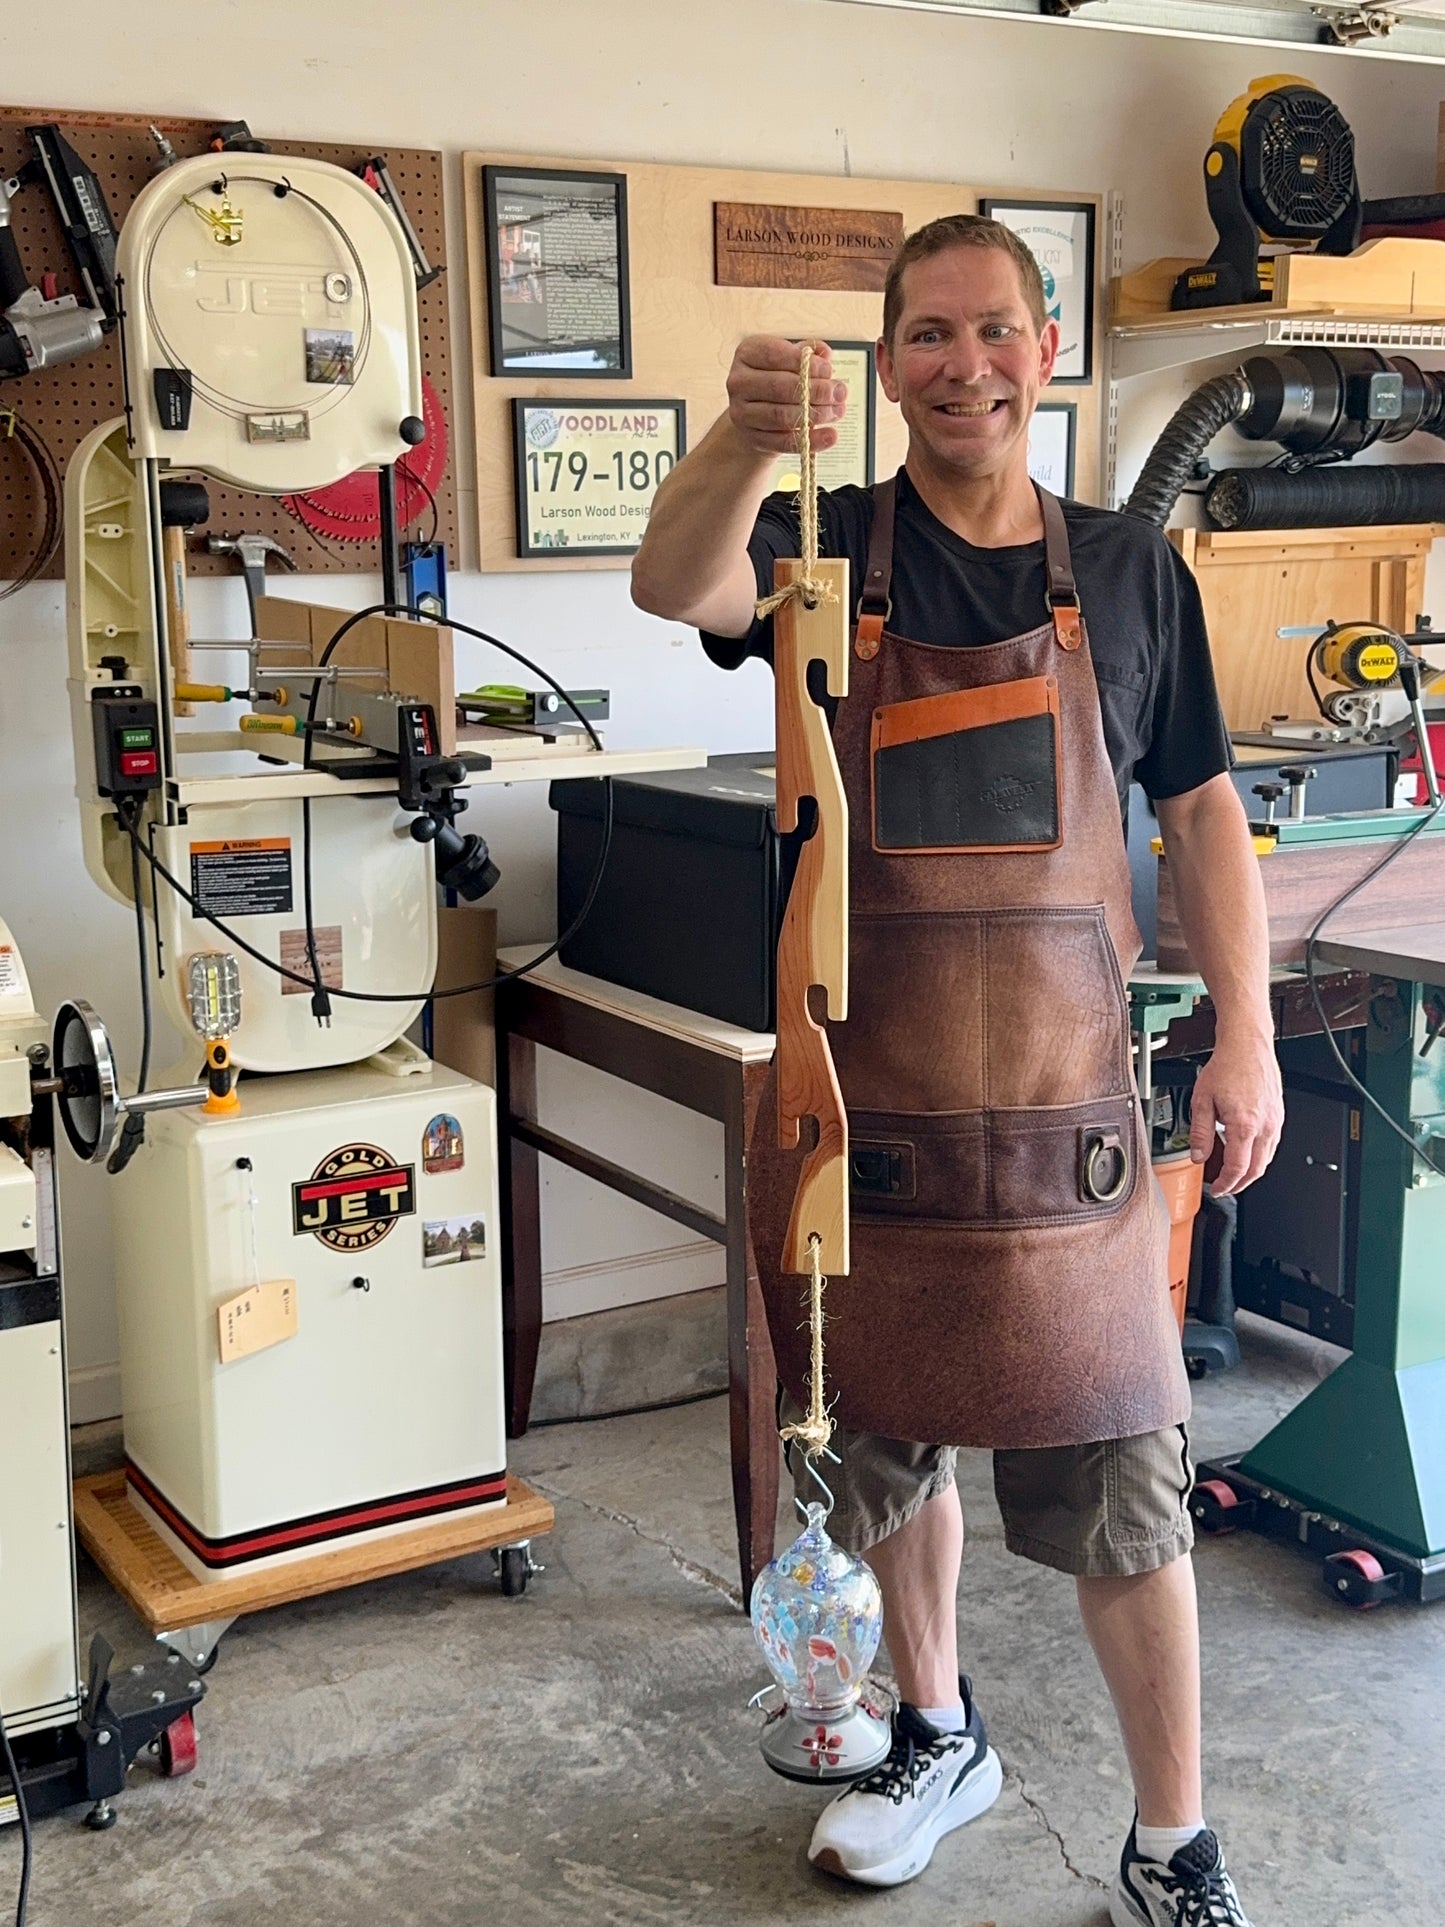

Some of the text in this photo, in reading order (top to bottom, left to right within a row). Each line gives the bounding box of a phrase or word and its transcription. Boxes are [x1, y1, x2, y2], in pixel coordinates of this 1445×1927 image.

[499, 213, 531, 221] STATEMENT
[727, 228, 894, 250] LARSON WOOD DESIGNS
[528, 450, 674, 492] 179-180
[541, 506, 581, 518] Larson
[585, 505, 616, 517] Wood
[577, 531, 631, 543] Lexington, KY
[412, 711, 431, 756] JET
[232, 841, 262, 849] WARNING
[325, 1150, 386, 1175] GOLD
[302, 1184, 408, 1227] JET
[327, 1221, 386, 1247] SERIES
